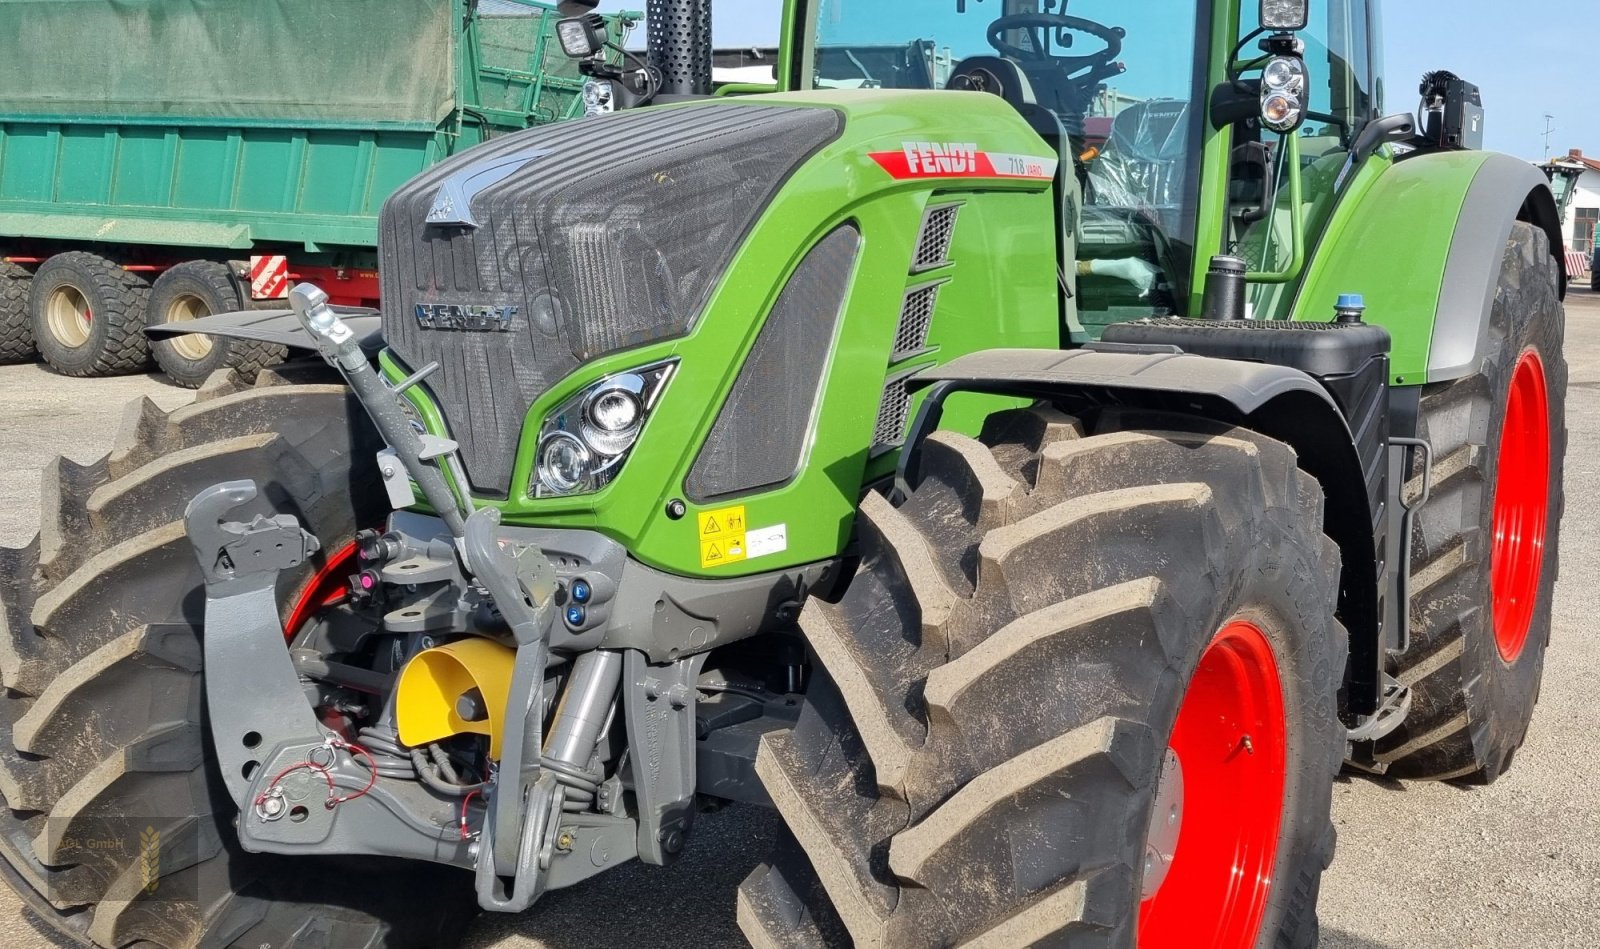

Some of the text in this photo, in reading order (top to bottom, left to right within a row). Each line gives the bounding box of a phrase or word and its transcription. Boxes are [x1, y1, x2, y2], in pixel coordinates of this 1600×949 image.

[901, 141, 1042, 177] FENDT 718 VARIO
[414, 302, 518, 331] FENDT
